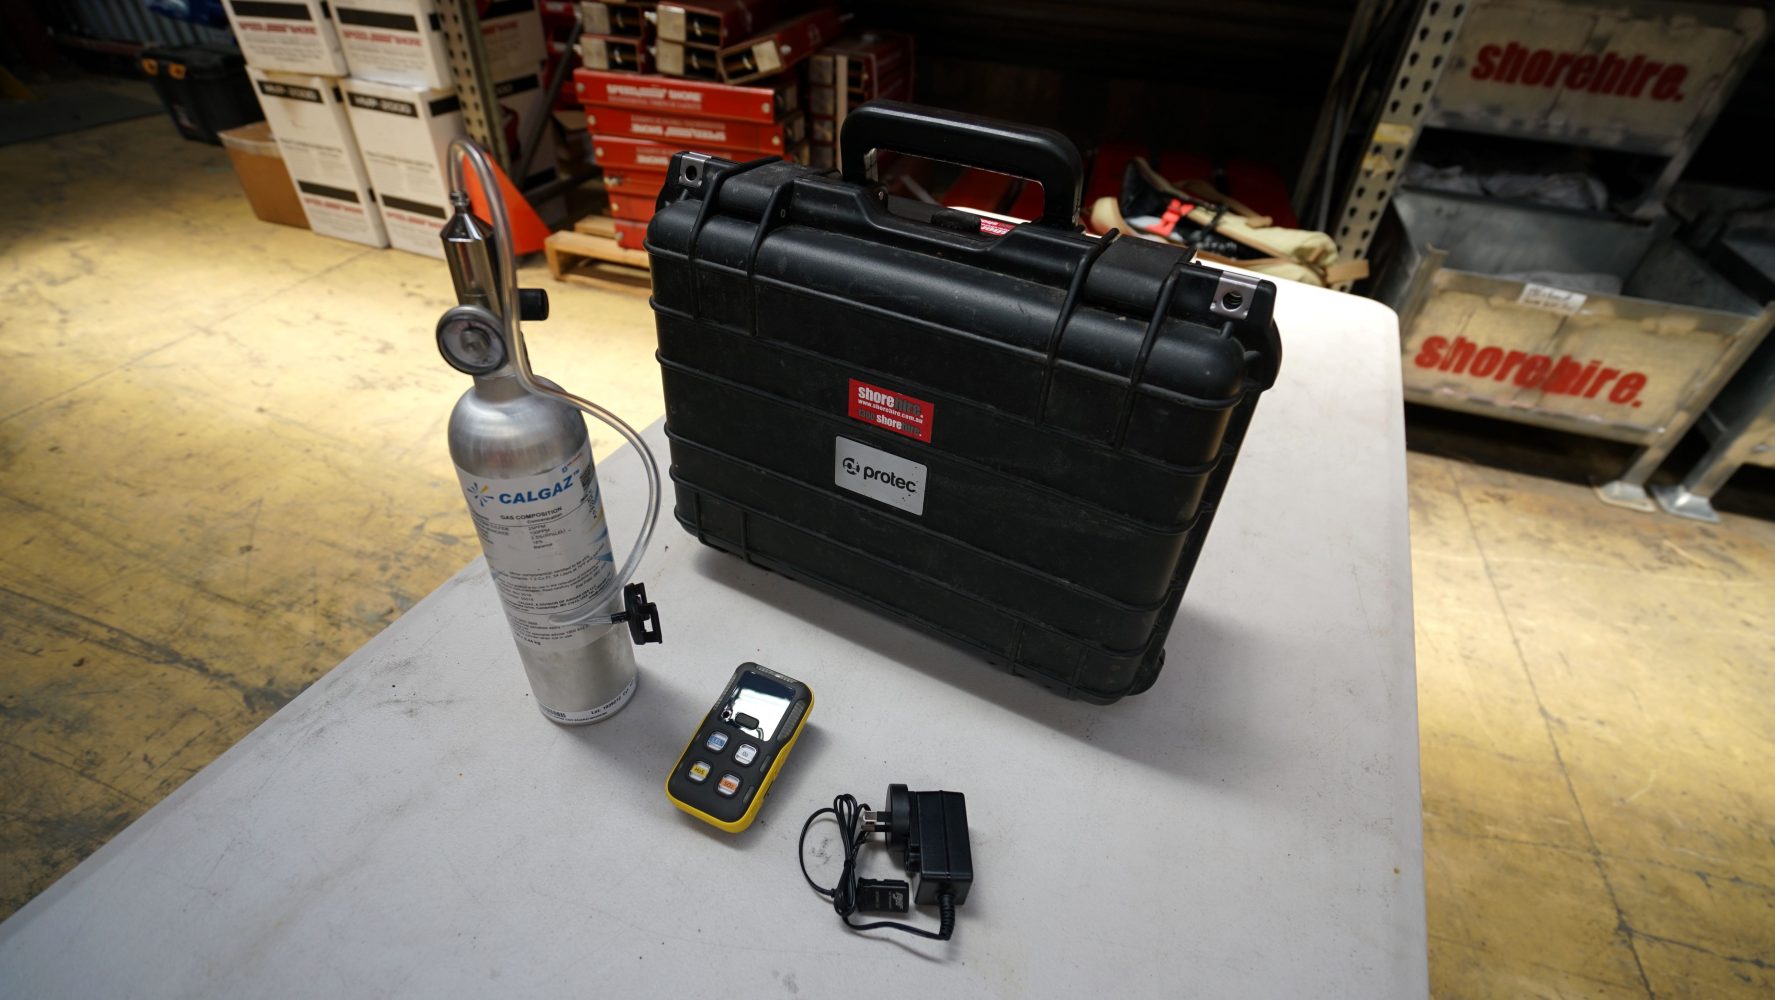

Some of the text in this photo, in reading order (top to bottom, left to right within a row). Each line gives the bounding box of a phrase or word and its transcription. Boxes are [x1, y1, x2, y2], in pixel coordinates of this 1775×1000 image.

[1471, 42, 1688, 101] shorehire.
[1414, 335, 1648, 407] shorehire.
[858, 399, 923, 424] www.shorehire.com.au
[863, 466, 916, 493] protec
[515, 506, 562, 520] COMPOSITION
